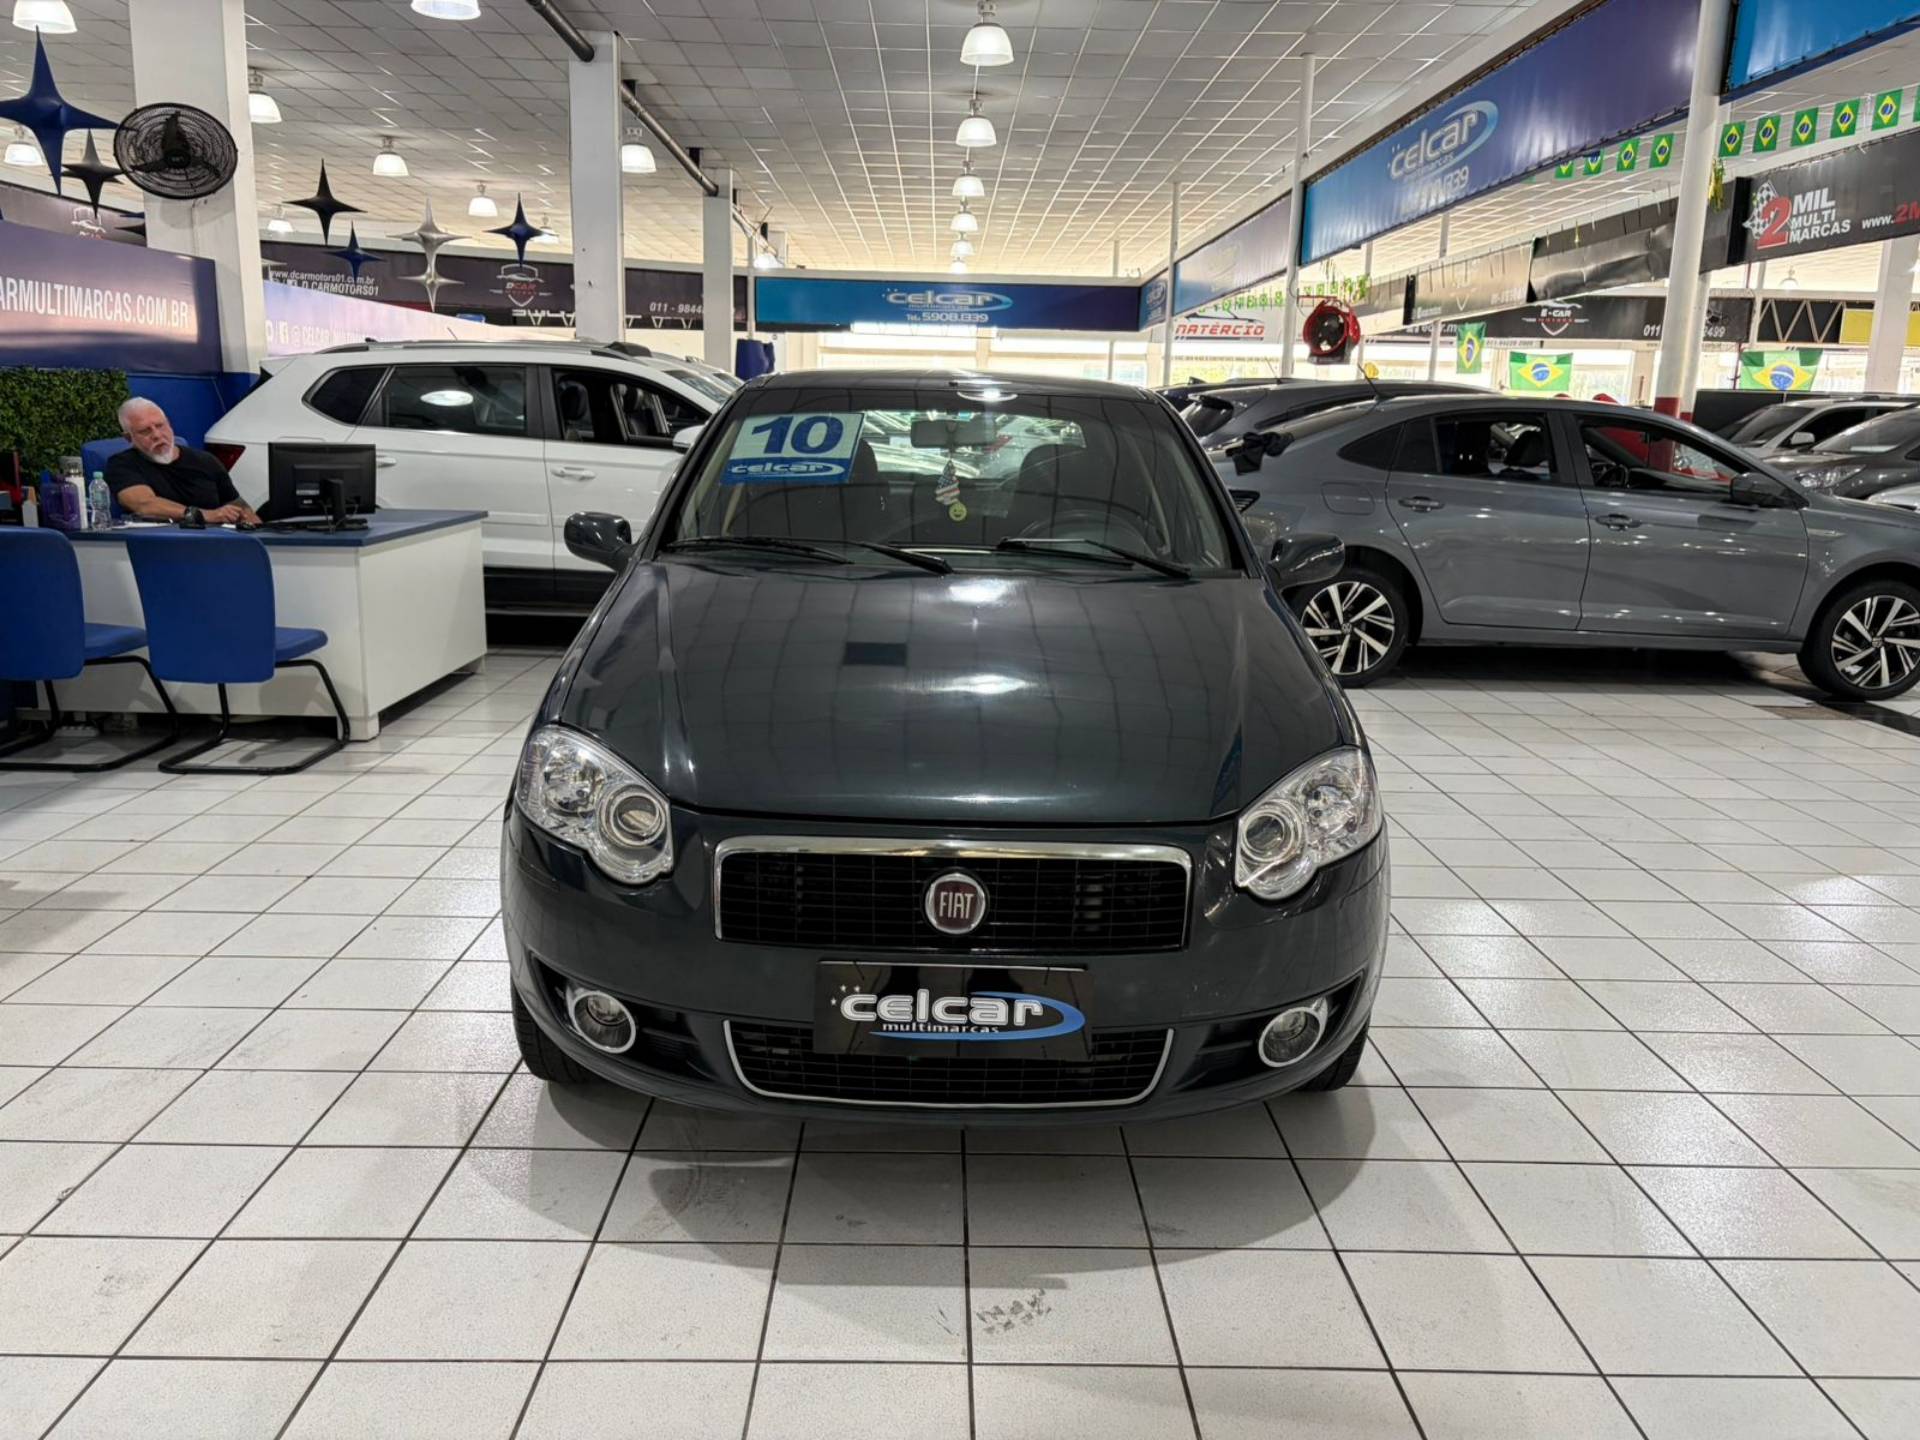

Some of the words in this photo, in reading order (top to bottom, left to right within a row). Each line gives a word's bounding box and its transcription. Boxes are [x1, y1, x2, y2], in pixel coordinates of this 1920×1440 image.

[1391, 111, 1478, 179] celcar
[1757, 196, 1792, 249] 2
[1792, 188, 1836, 215] MIL
[1791, 209, 1837, 230] MULTI
[1789, 219, 1852, 244] MARCAS
[649, 302, 668, 312] 011
[678, 303, 704, 314] 9844
[887, 291, 992, 305] celcar
[1643, 324, 1661, 337] 011
[752, 416, 844, 454] 10
[731, 463, 824, 474] celcar
[939, 891, 975, 919] FIAT
[841, 988, 1043, 1026] celcar
[882, 1021, 999, 1033] multimarcas
